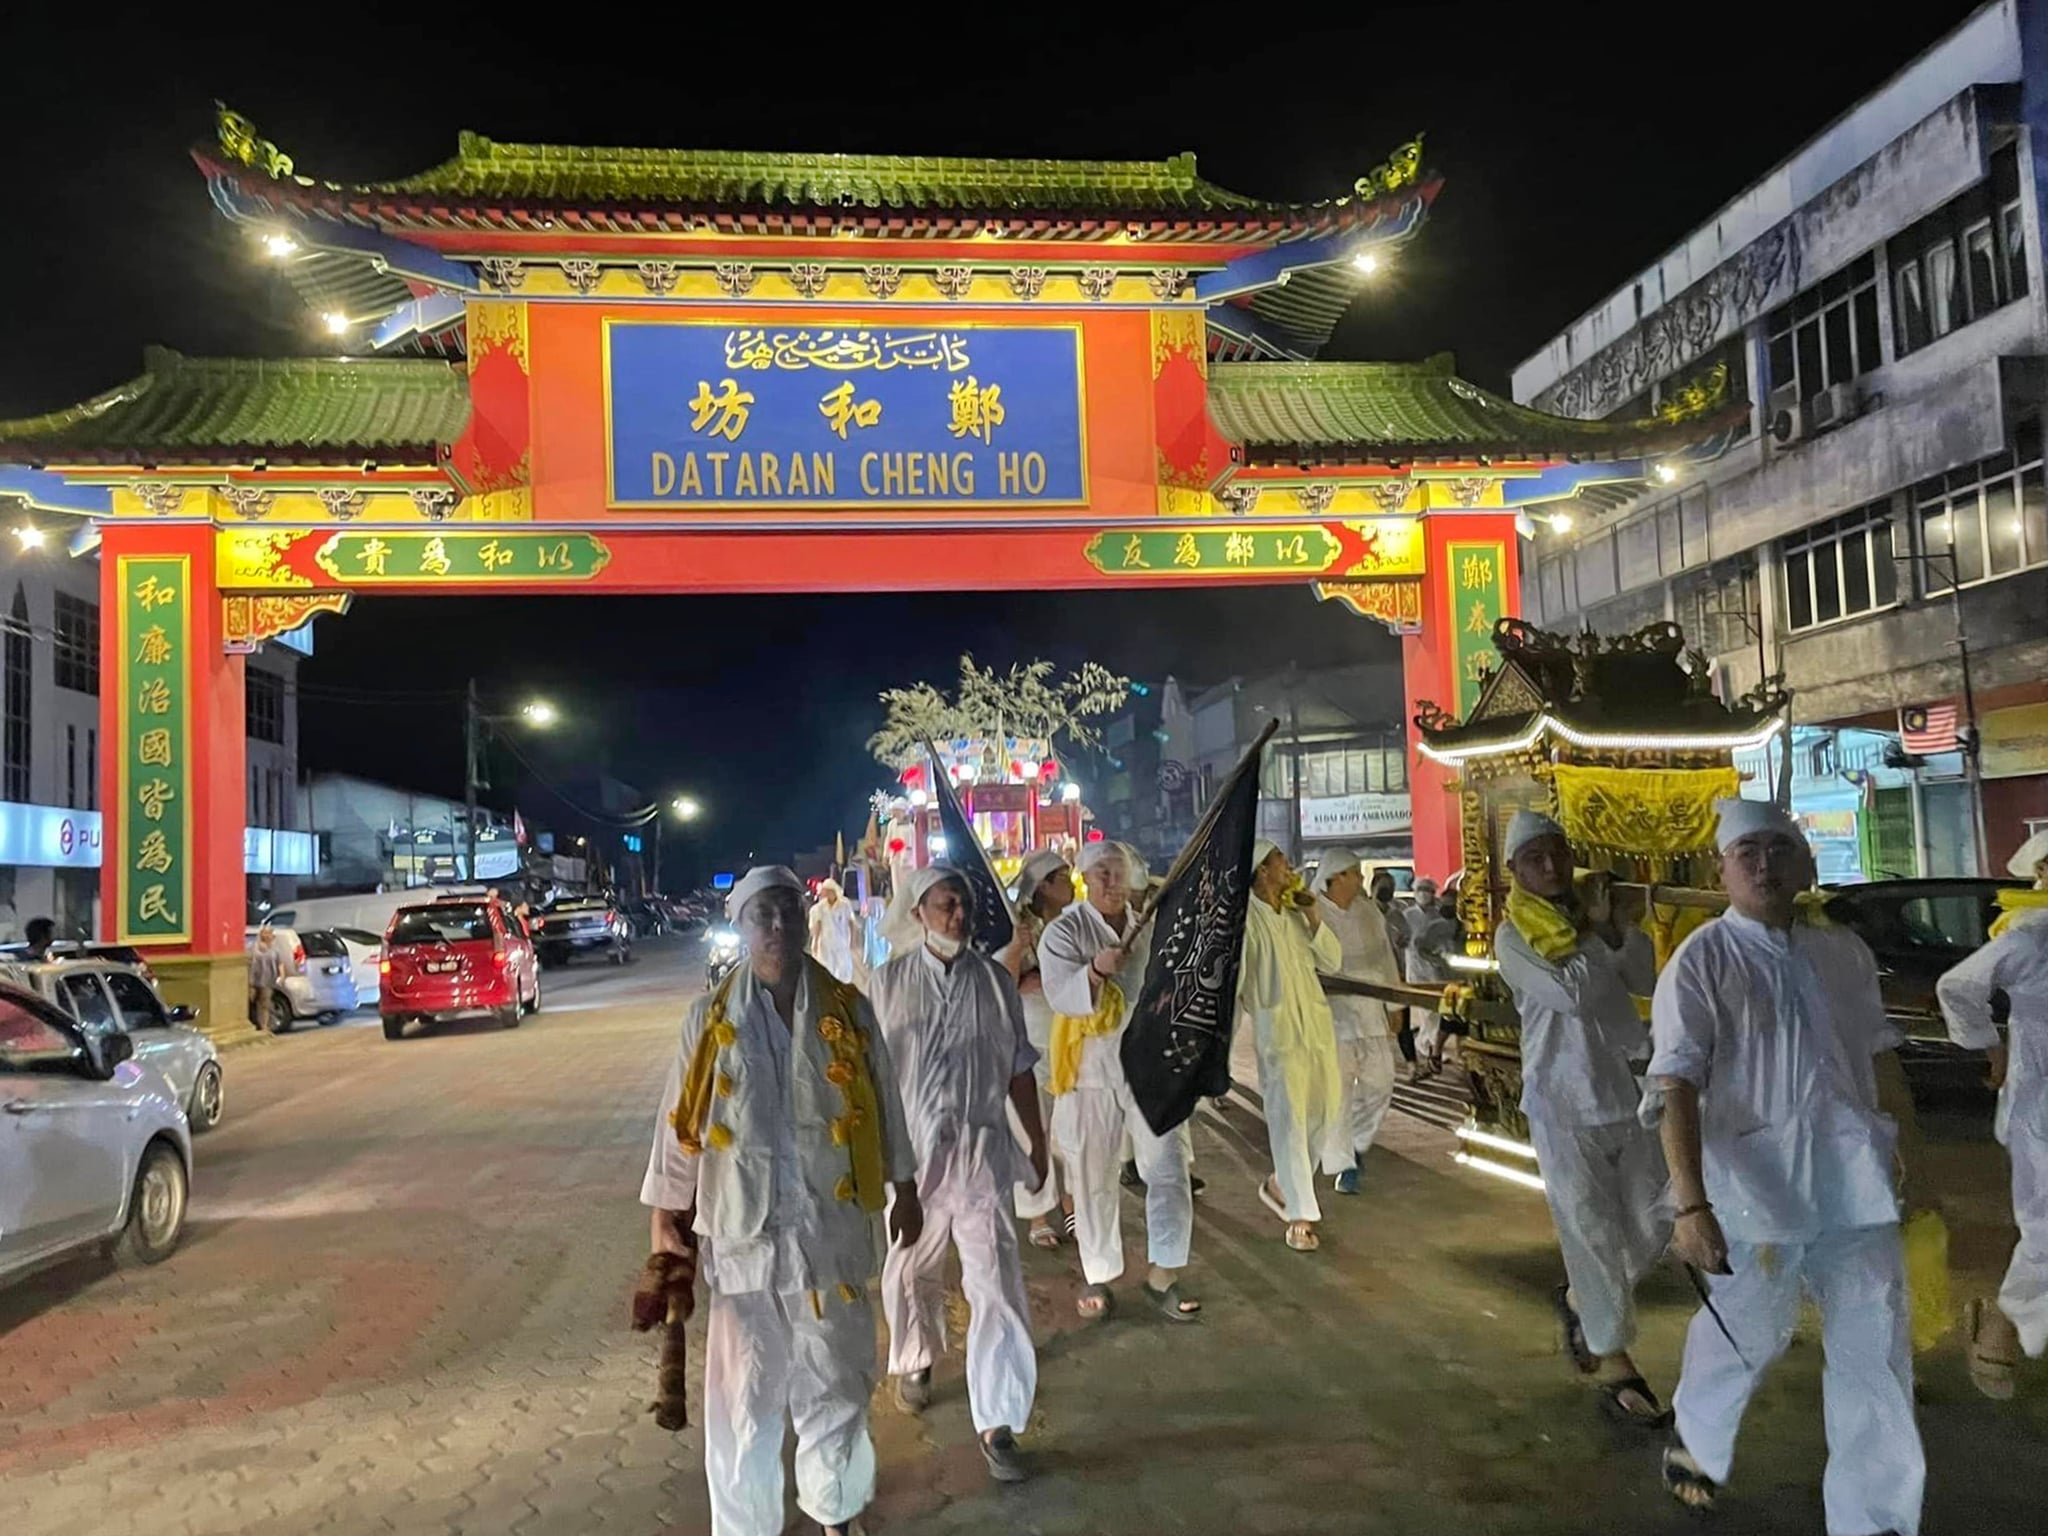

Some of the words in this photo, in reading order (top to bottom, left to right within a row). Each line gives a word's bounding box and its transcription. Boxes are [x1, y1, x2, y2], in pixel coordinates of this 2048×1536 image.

[651, 451, 836, 497] DATARAN
[859, 451, 975, 496] CHENG
[998, 450, 1047, 496] HO
